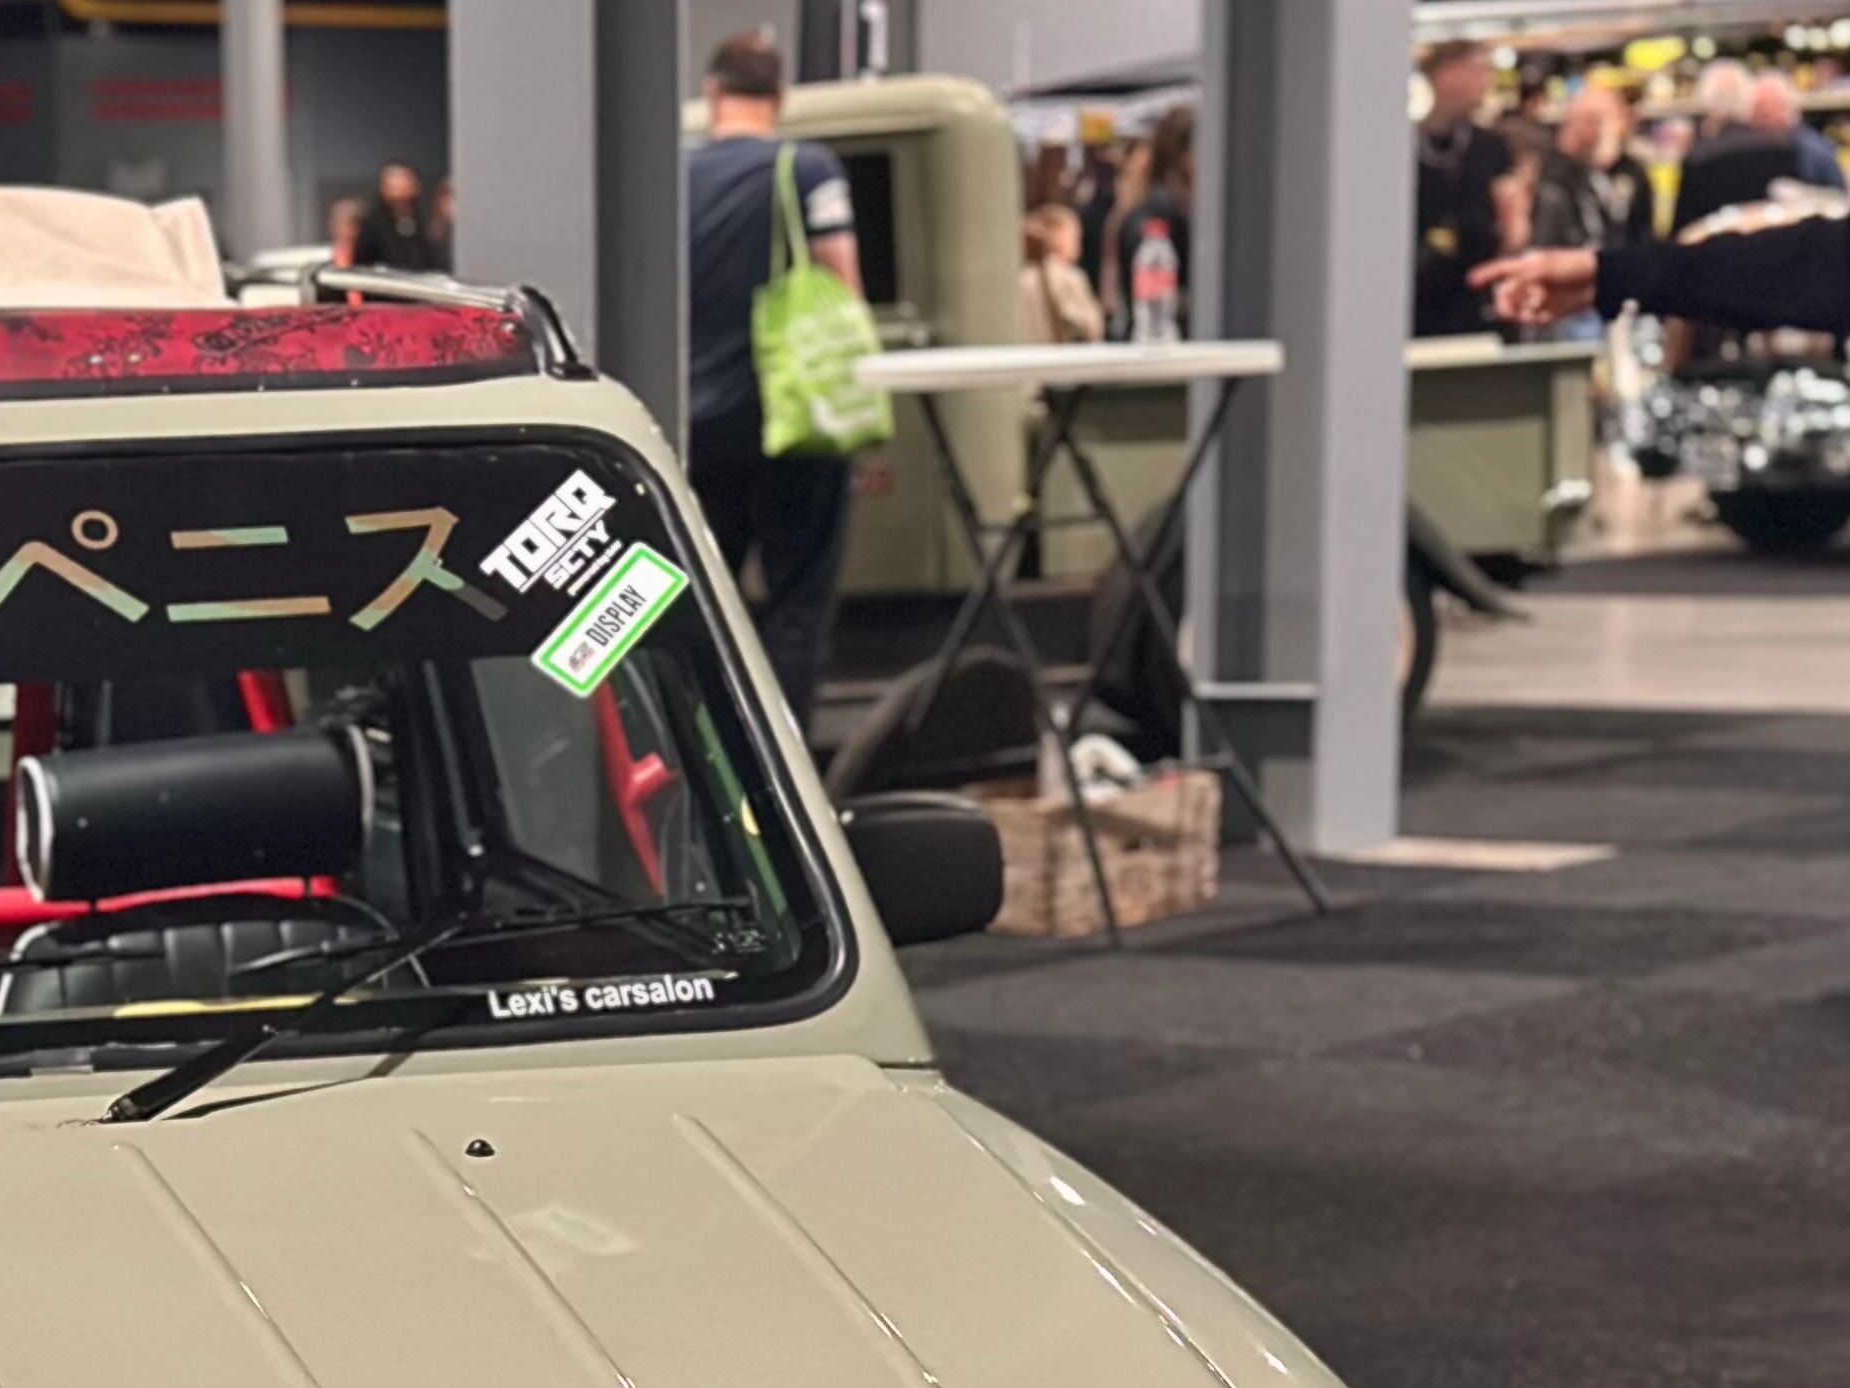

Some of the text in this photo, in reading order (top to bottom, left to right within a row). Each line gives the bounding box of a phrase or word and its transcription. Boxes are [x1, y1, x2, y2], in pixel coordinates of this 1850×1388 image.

[543, 519, 610, 590] SCTY
[585, 584, 648, 648] DISPLAY
[487, 973, 716, 1018] Lexi's carsalon
